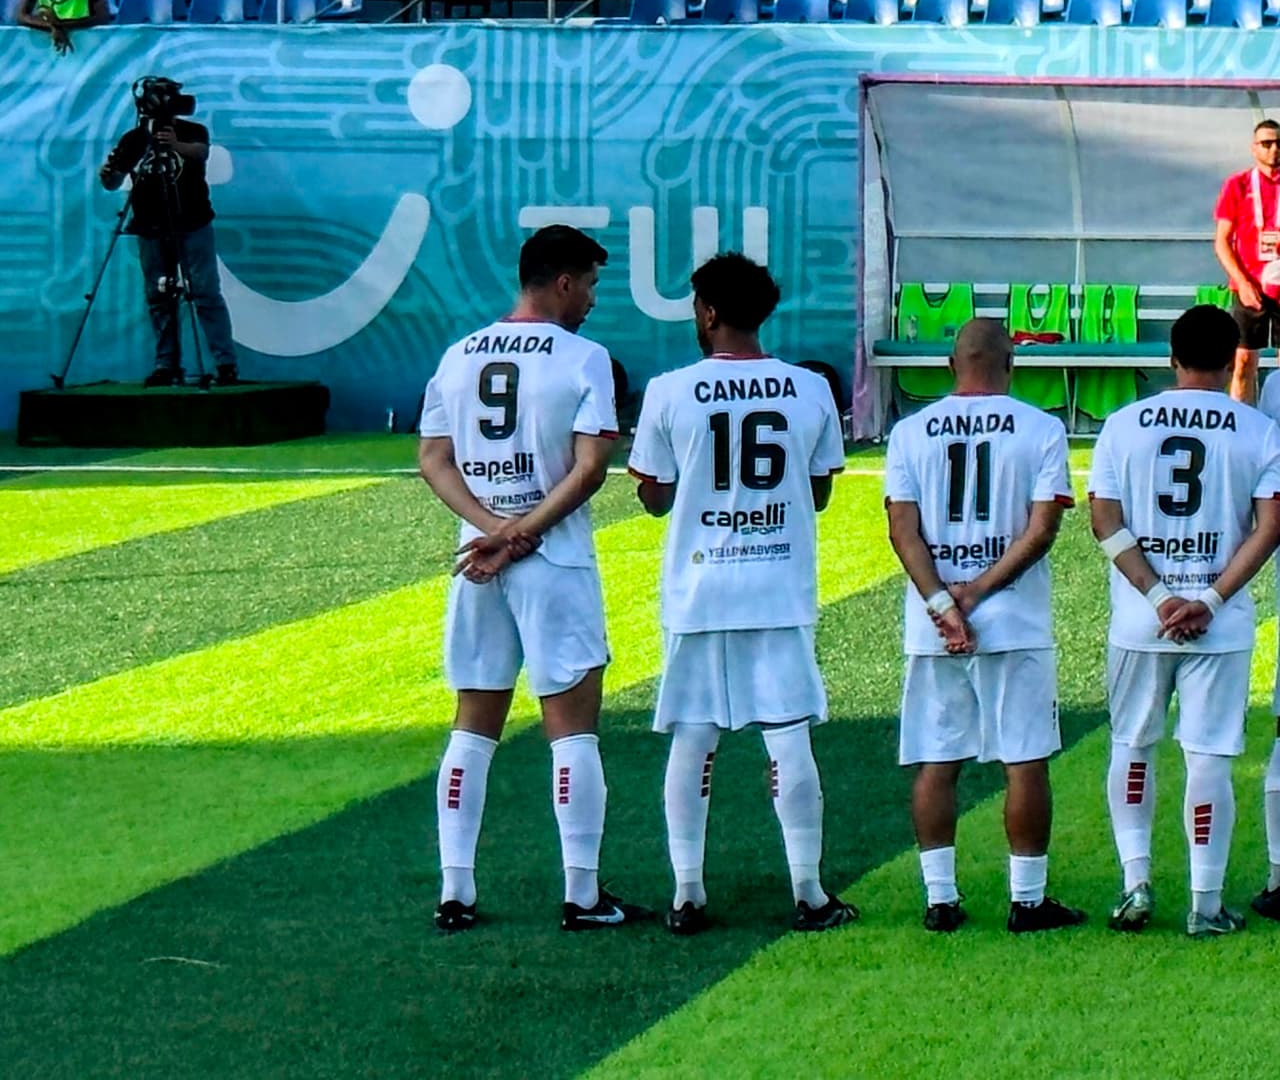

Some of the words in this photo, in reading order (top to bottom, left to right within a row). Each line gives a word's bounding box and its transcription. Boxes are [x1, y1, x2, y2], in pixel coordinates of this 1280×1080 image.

[464, 335, 554, 355] CANADA
[478, 361, 520, 441] 9
[694, 376, 798, 404] CANADA
[926, 413, 1015, 437] CANADA
[1138, 406, 1237, 433] CANADA
[708, 410, 789, 492] 16
[462, 452, 535, 482] capelli
[495, 474, 534, 486] SPORT
[947, 440, 991, 522] 11
[1157, 435, 1206, 517] 3
[700, 502, 786, 533] capelli
[740, 525, 784, 536] SPORT
[930, 536, 1006, 566] capelli
[1136, 531, 1220, 561] capelli
[1172, 554, 1216, 564] SPORT
[960, 560, 999, 571] SPOR
